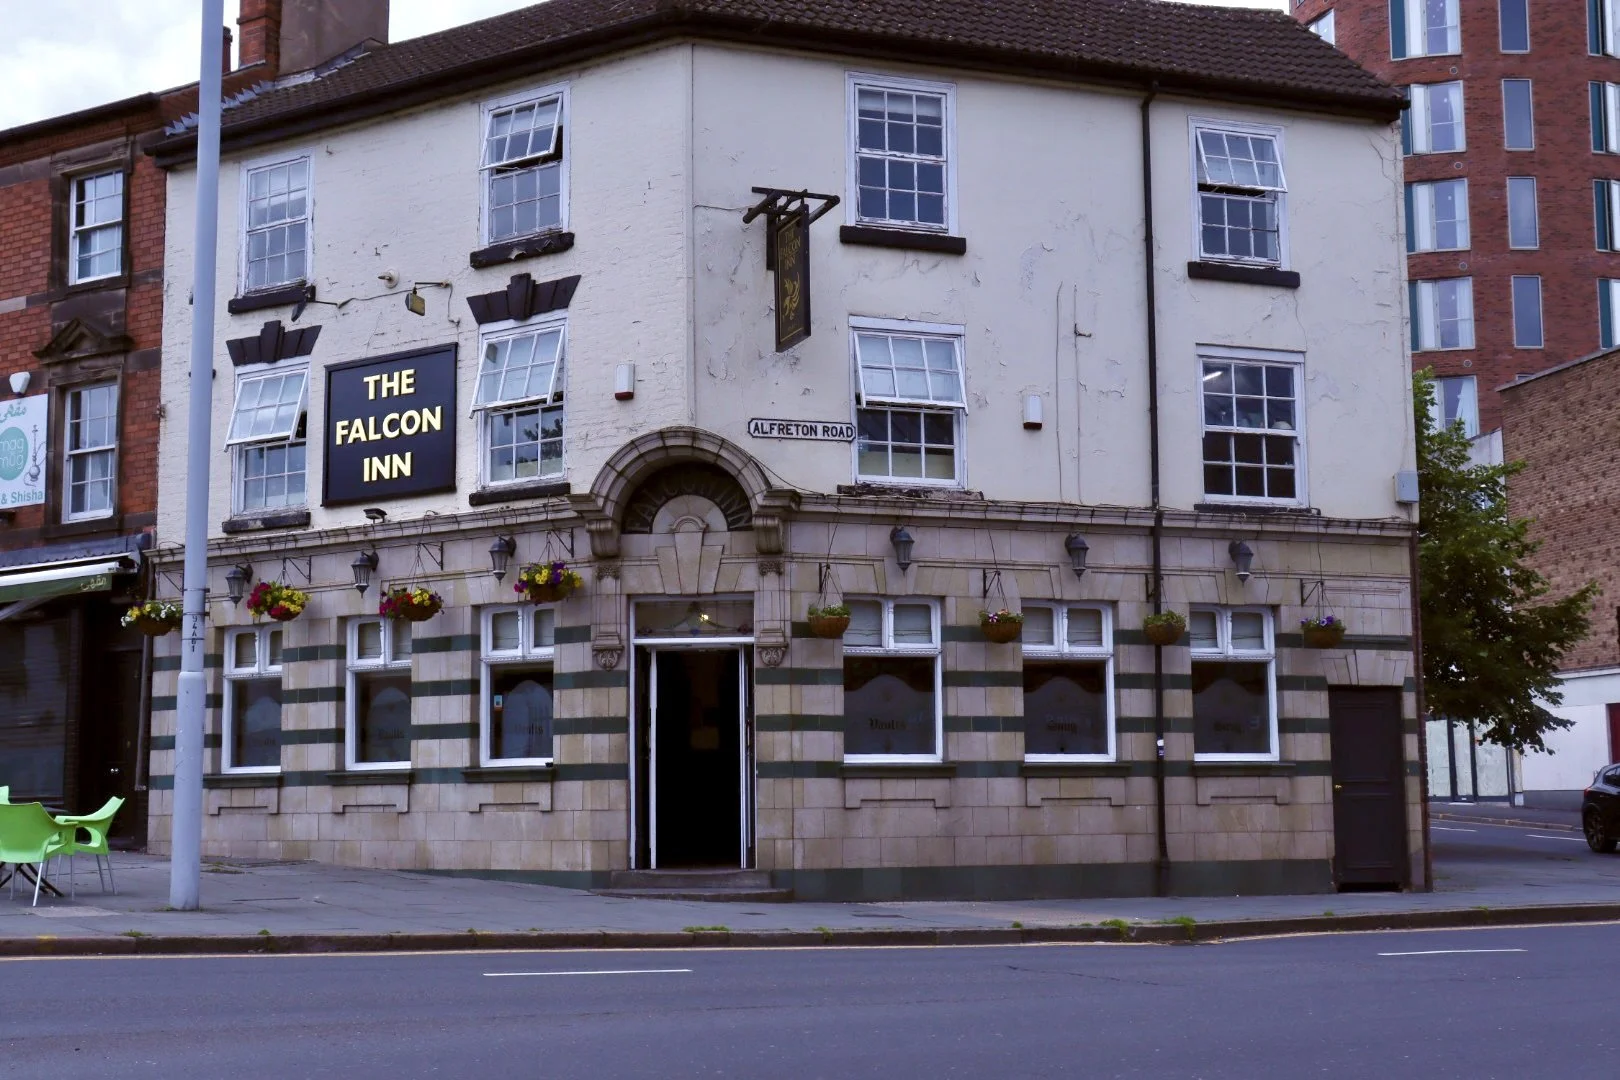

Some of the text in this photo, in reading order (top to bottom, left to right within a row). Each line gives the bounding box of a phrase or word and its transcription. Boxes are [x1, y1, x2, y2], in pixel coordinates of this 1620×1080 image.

[363, 369, 415, 400] THE
[335, 406, 442, 445] FALCON
[753, 422, 853, 438] ALFRETON ROAD
[363, 452, 412, 482] INN
[1, 490, 43, 505] & Shisha
